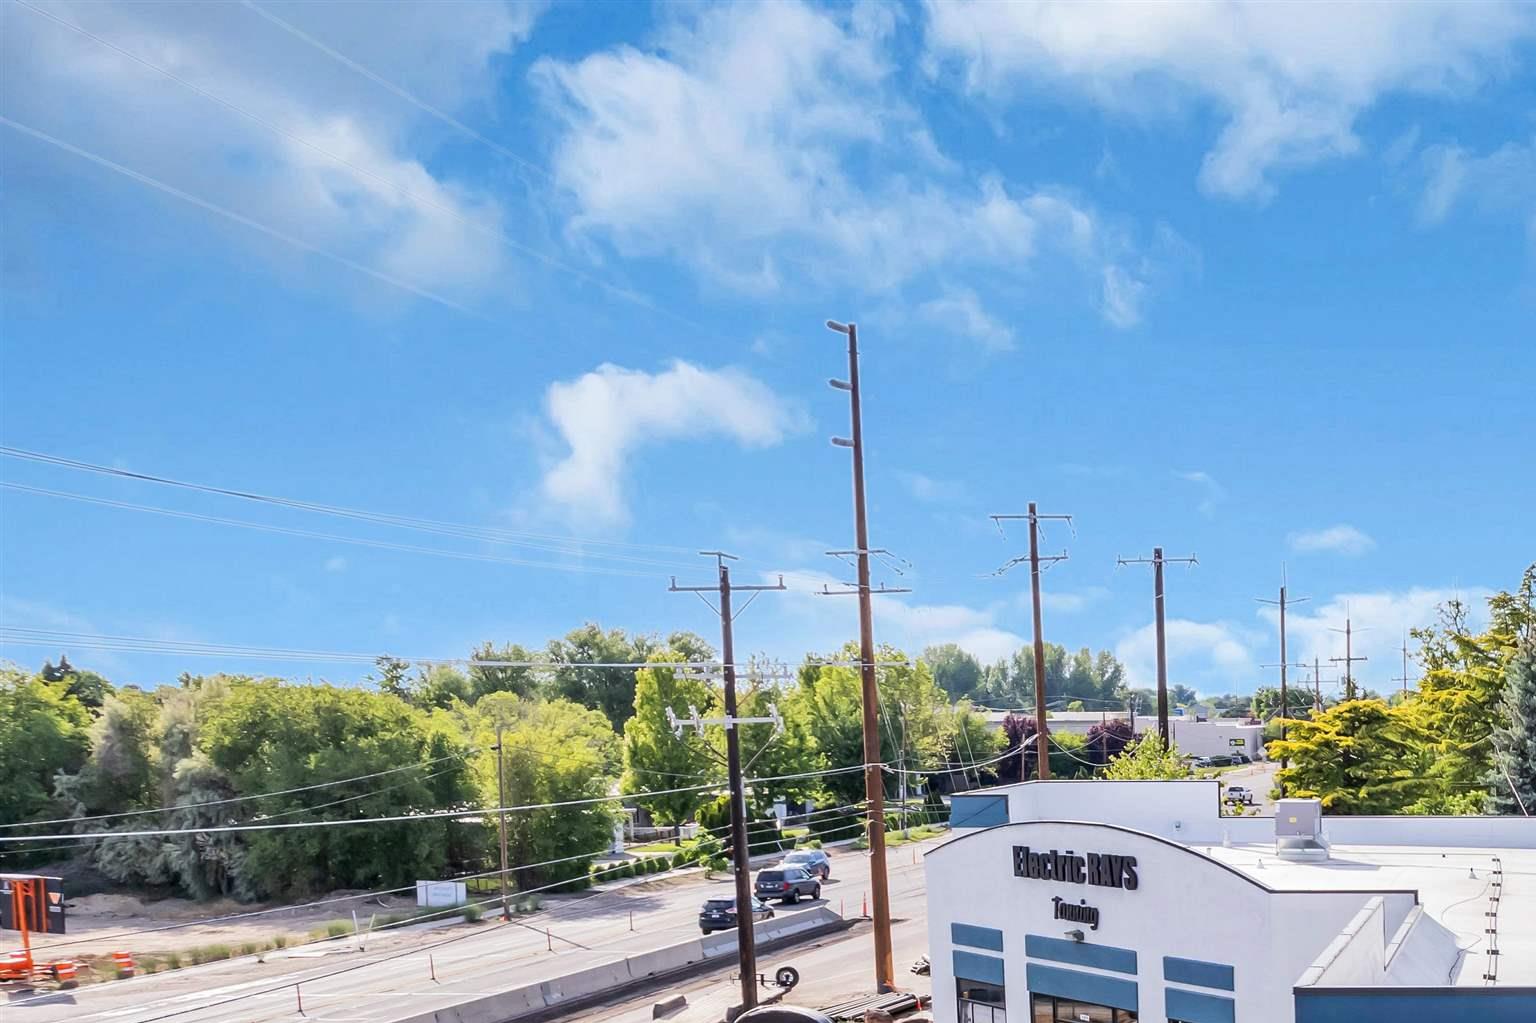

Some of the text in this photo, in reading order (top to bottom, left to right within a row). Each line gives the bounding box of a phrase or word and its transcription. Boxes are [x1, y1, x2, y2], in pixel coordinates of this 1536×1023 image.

[1012, 845, 1139, 891] Electric RAYS
[1051, 896, 1100, 931] Tanning
